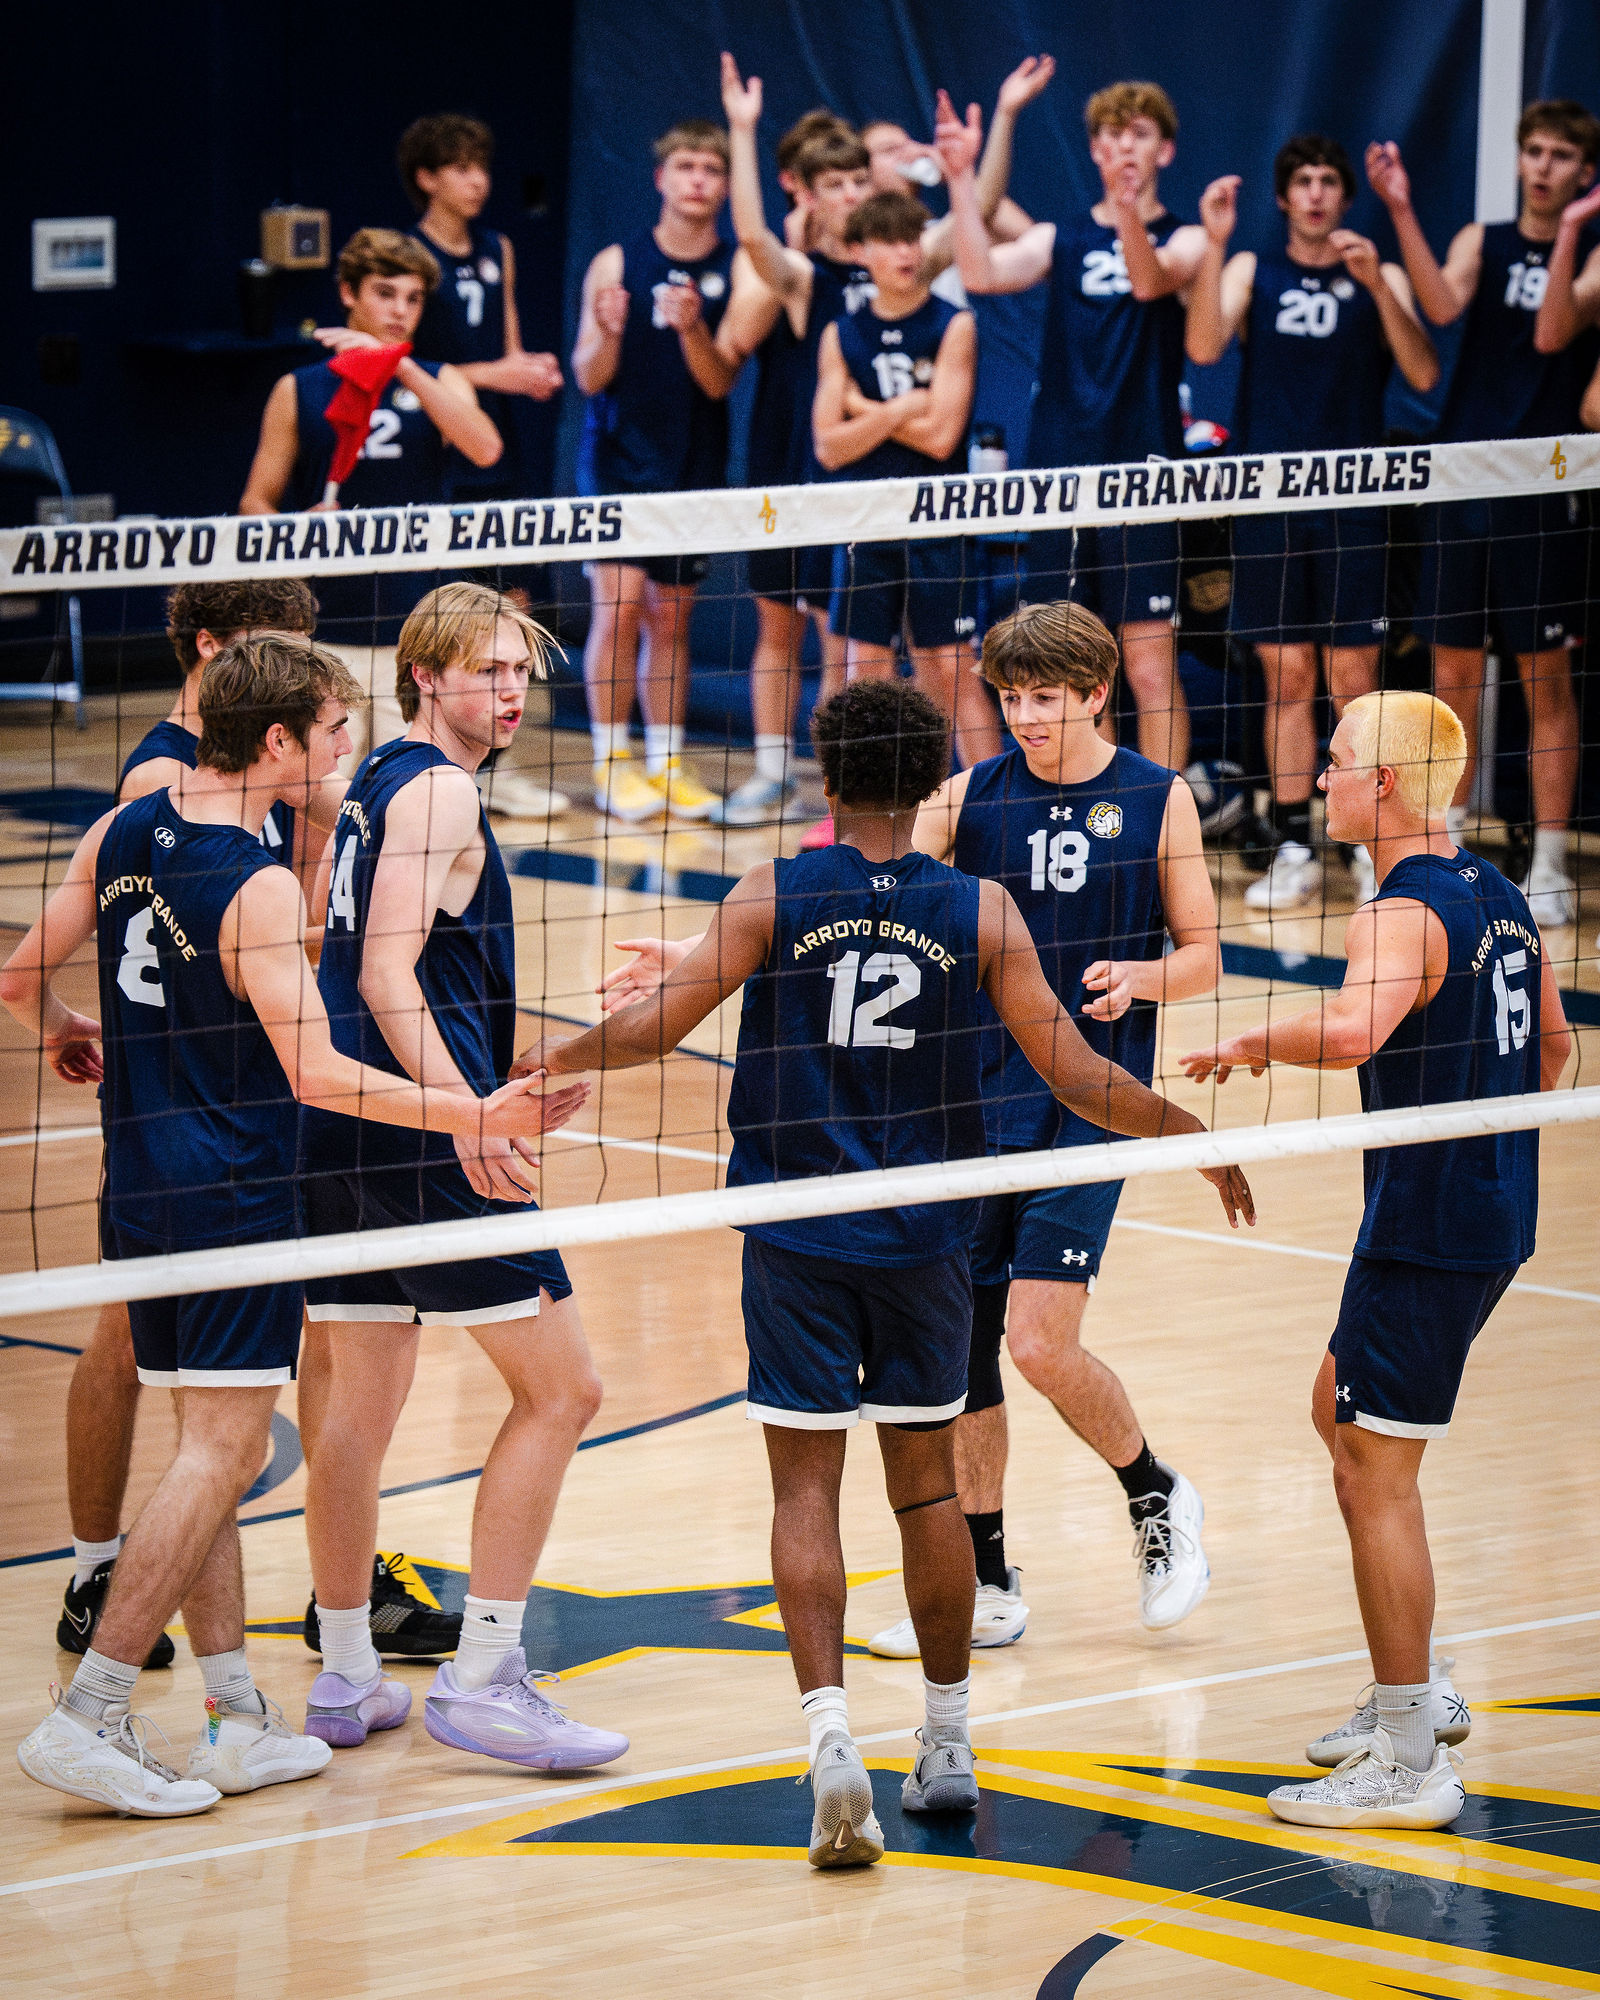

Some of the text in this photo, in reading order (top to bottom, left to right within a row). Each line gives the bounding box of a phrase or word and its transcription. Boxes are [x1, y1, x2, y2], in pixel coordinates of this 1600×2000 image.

[456, 279, 485, 327] 7
[1276, 289, 1339, 338] 20
[1504, 262, 1551, 311] 19
[357, 408, 403, 460] 2
[909, 450, 1432, 523] ARROYO GRANDE EAGLES
[12, 501, 622, 575] ARROYO GRANDE EAGLES
[1027, 829, 1090, 893] 18
[151, 893, 198, 962] RANDE
[793, 918, 958, 973] ARROYO GRANDE
[826, 950, 922, 1050] 12
[1492, 949, 1531, 1056] 15
